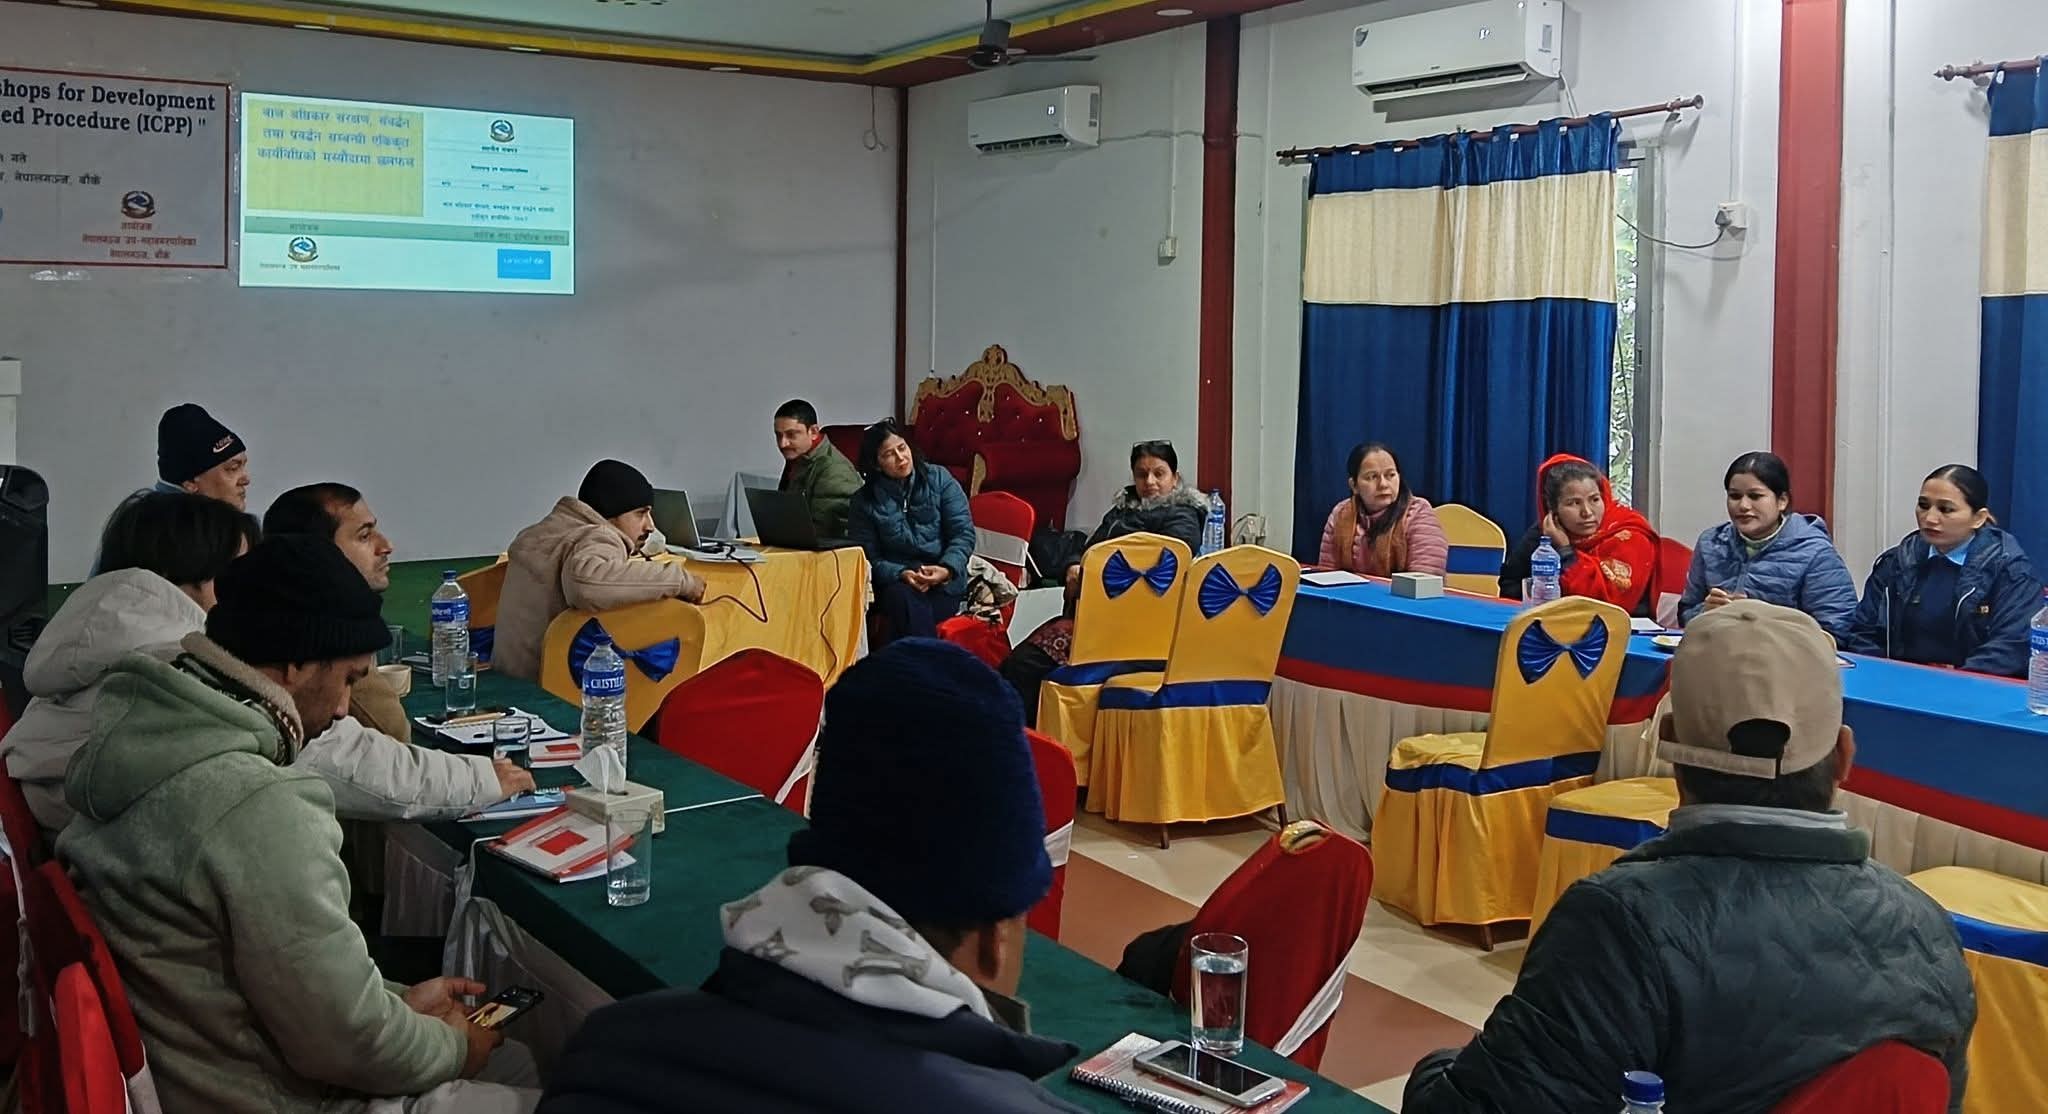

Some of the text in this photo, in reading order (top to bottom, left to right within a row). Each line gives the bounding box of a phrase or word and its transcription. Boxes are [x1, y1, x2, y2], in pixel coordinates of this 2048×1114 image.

[58, 82, 85, 102] for
[91, 86, 215, 111] Development
[32, 108, 130, 131] Procedure
[137, 113, 193, 137] (ICPP)
